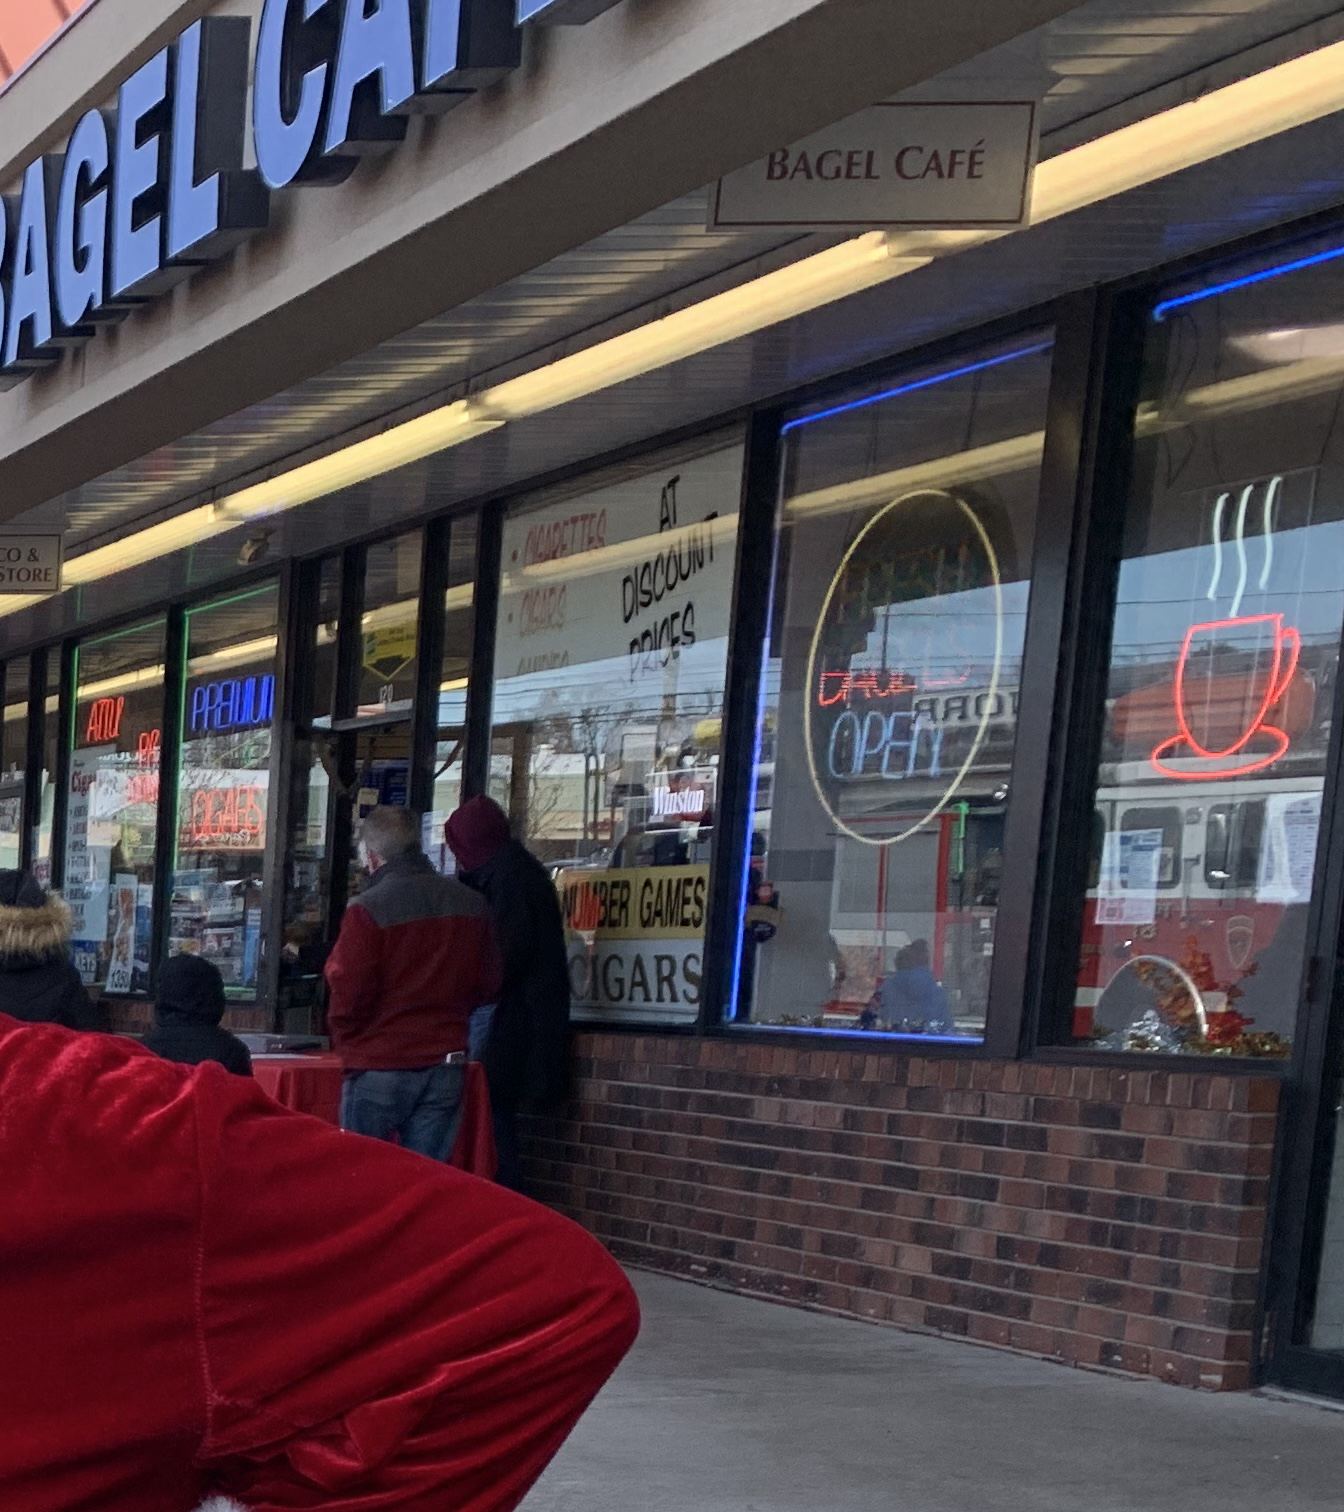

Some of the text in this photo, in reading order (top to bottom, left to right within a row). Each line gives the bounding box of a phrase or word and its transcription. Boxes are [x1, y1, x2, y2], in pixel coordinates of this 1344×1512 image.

[253, 0, 557, 188] CA
[765, 138, 986, 181] BAGEL CAFÉ
[659, 474, 681, 534] AT
[621, 510, 719, 624] DISCOUNT
[628, 601, 696, 684] PRICES
[652, 785, 705, 817] Winston
[562, 875, 706, 931] NUMBER GAMES
